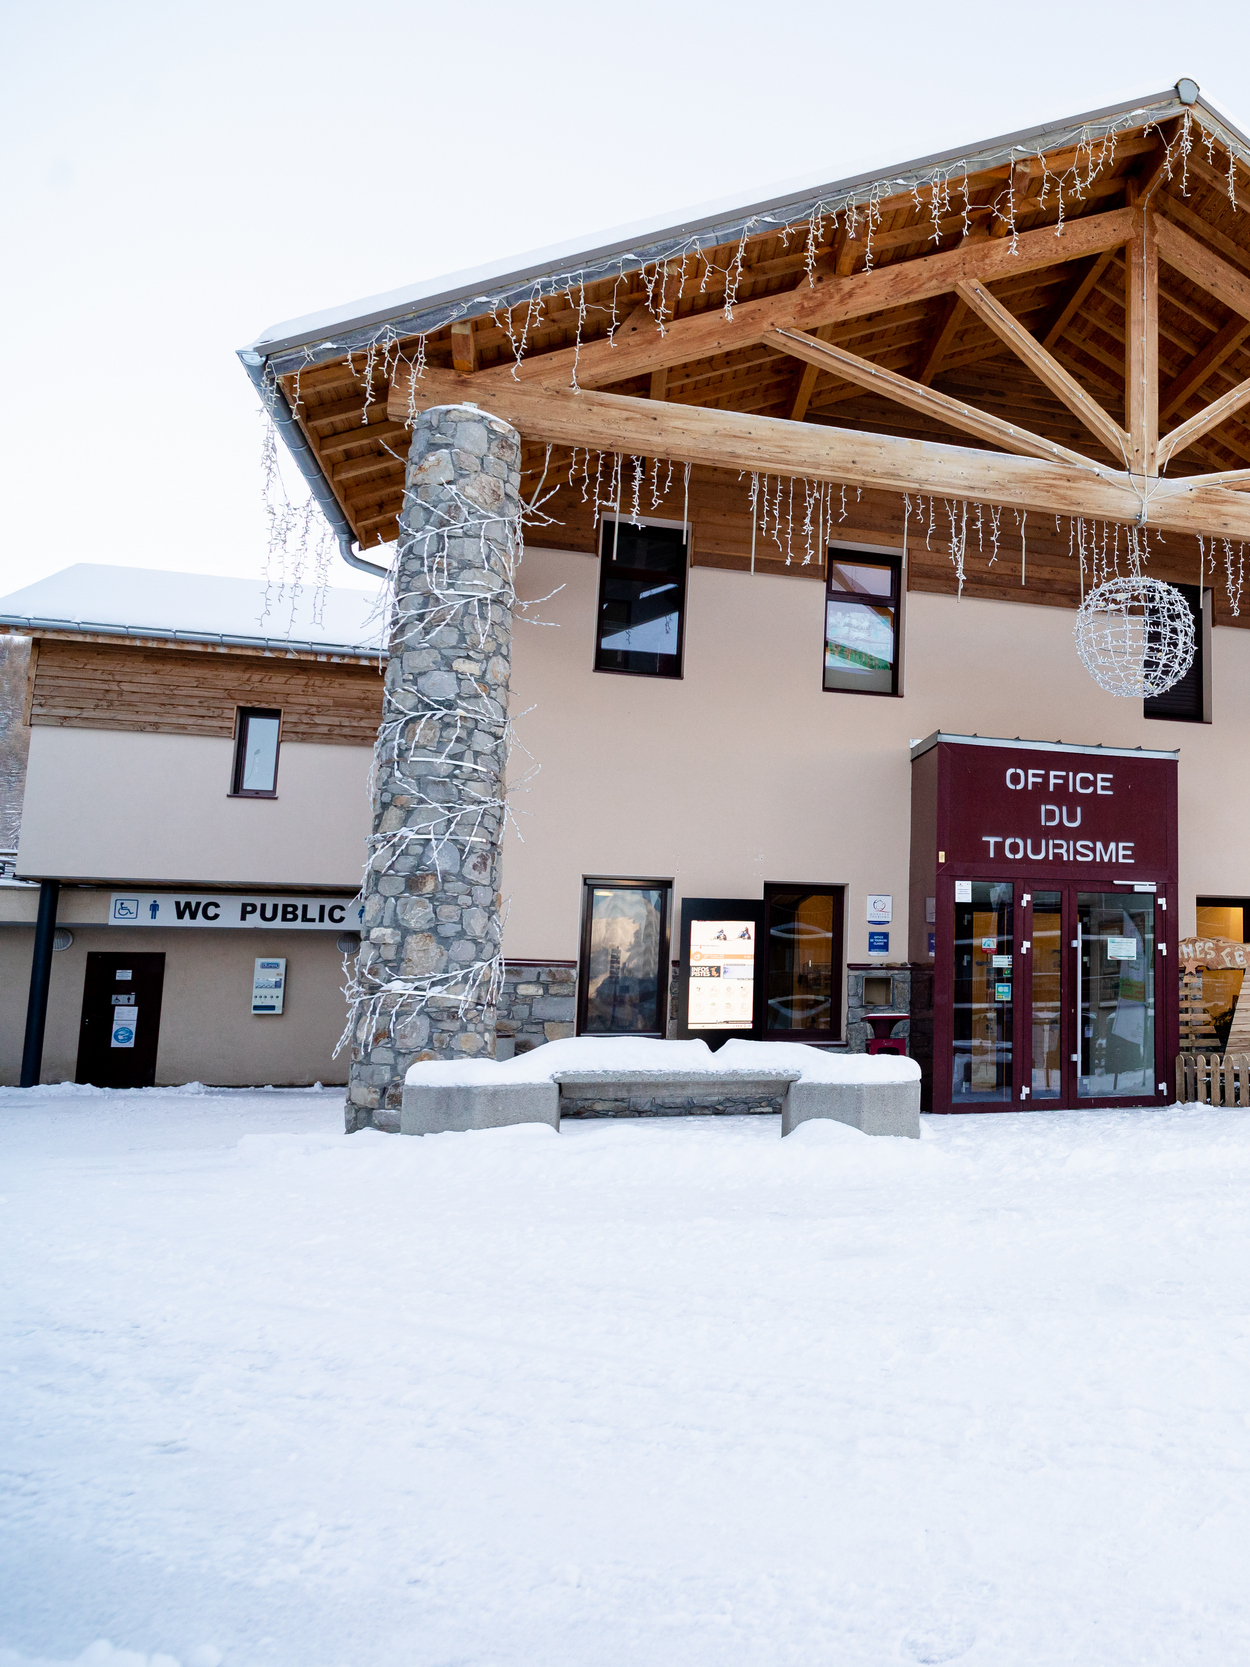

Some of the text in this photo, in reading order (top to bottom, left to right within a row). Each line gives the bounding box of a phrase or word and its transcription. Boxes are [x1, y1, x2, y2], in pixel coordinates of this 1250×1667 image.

[1005, 767, 1114, 795] OFFICE
[1040, 804, 1082, 828] DU
[981, 836, 1135, 863] TOURISME
[174, 900, 346, 924] WC PUBLIC
